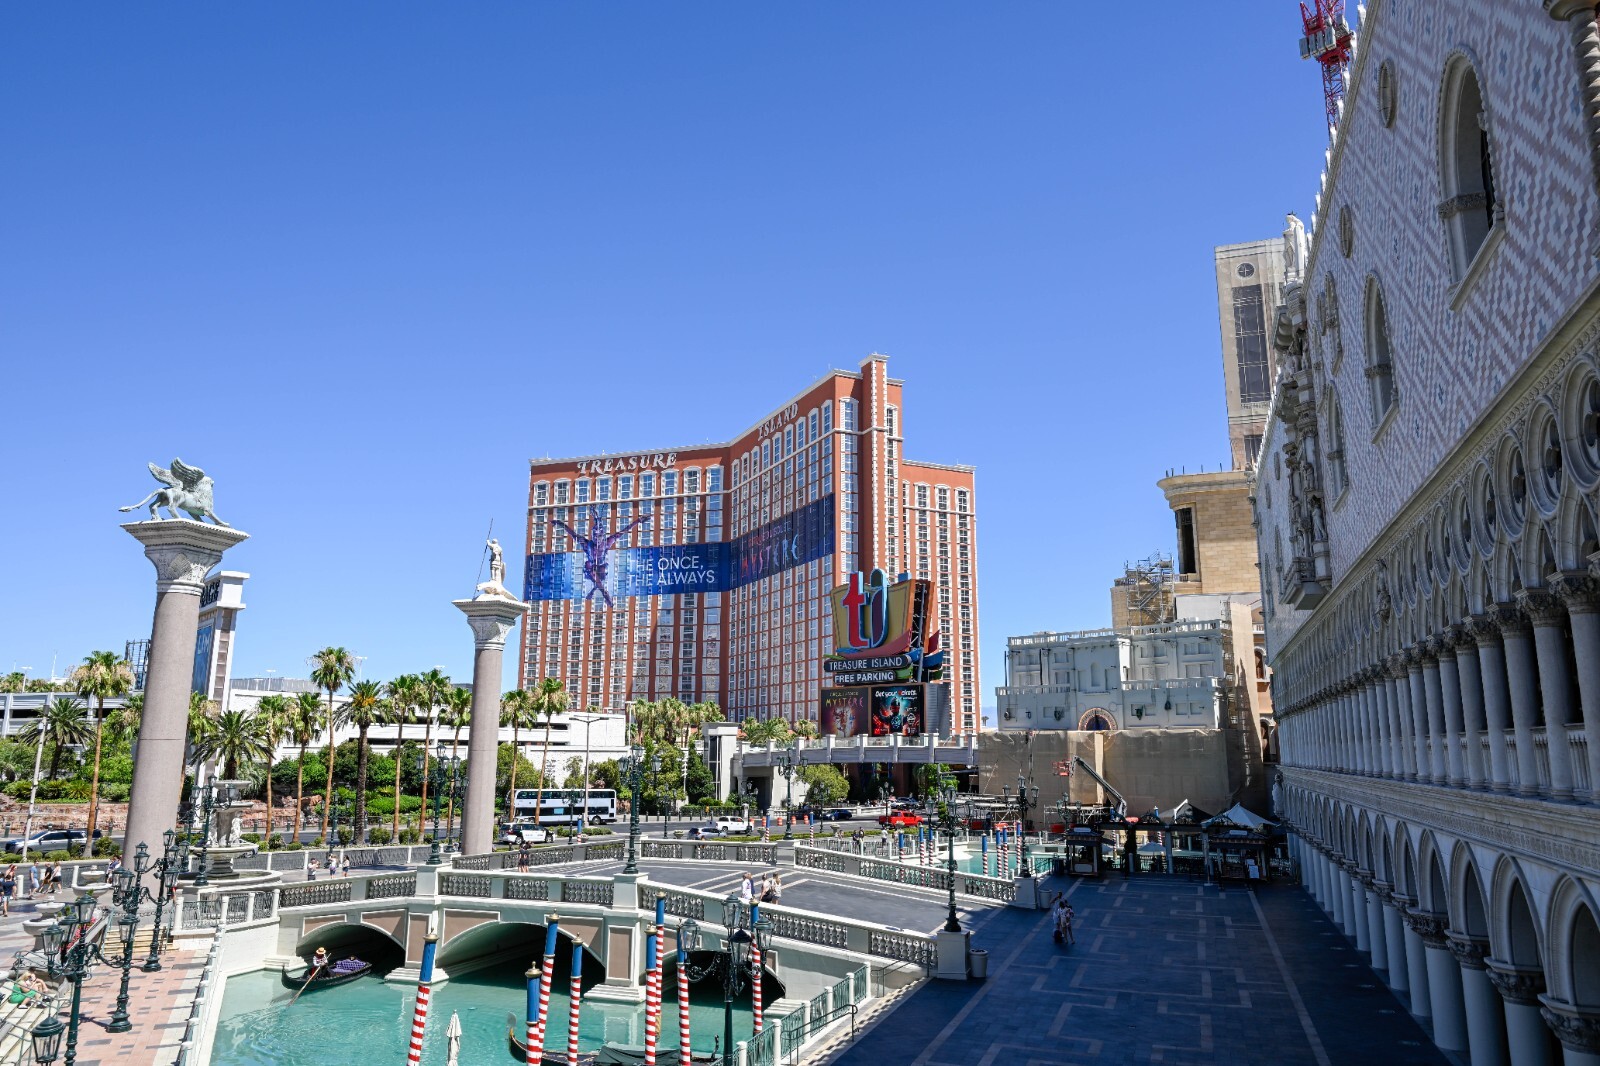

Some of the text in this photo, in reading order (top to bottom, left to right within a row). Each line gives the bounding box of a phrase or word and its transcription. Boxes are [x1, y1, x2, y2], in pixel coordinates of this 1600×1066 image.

[757, 402, 799, 441] ISLAND
[577, 452, 678, 475] TREASURE
[628, 555, 704, 573] THE ONCE,
[656, 569, 715, 586] ALWAYS
[829, 656, 903, 671] TREASURE ISLAND
[834, 671, 894, 683] FREE PARKING
